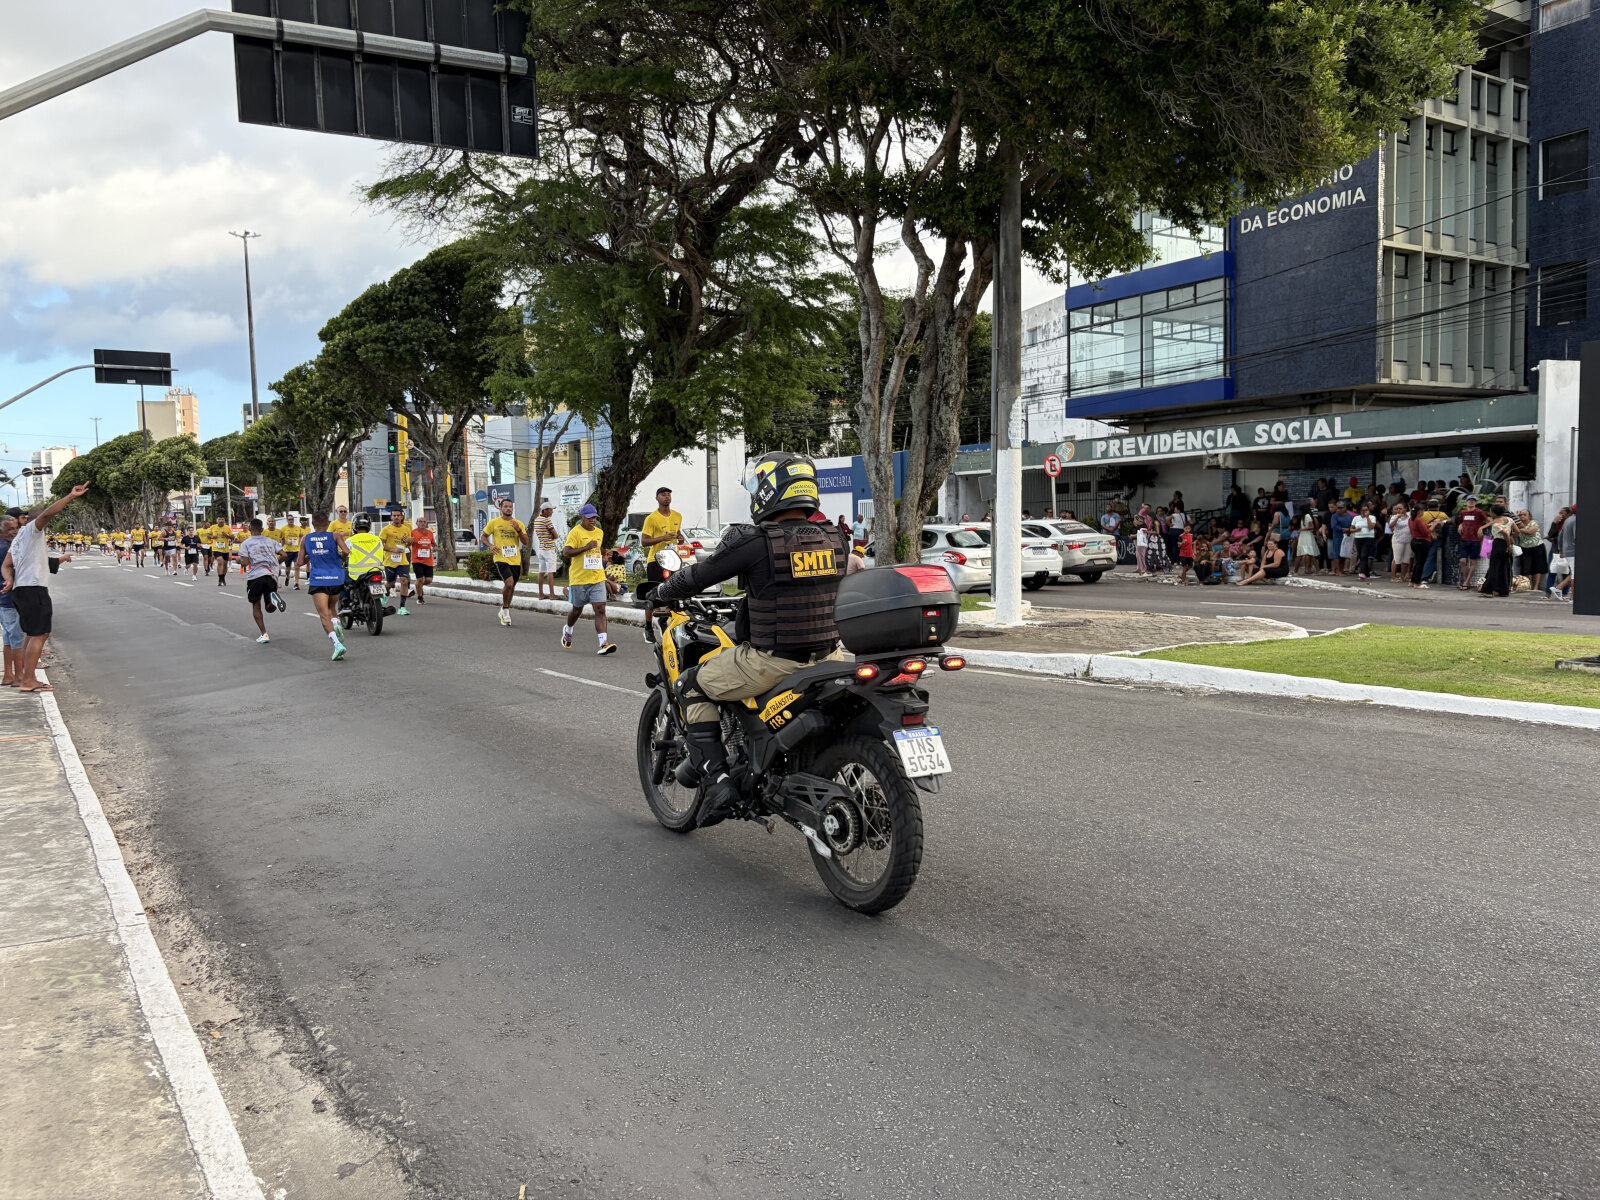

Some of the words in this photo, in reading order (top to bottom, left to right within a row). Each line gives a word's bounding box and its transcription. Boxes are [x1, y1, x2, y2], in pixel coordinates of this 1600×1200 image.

[1240, 215, 1263, 234] DA
[1267, 187, 1367, 227] ECONOMIA
[1096, 427, 1241, 459] PREVIDÊNCIA
[1254, 416, 1352, 445] SOCIAL
[818, 474, 851, 488] IDENCIÁRIA
[793, 550, 833, 571] SMTT
[769, 715, 786, 730] 118
[907, 737, 935, 755] TNS
[908, 753, 945, 773] 5C34
